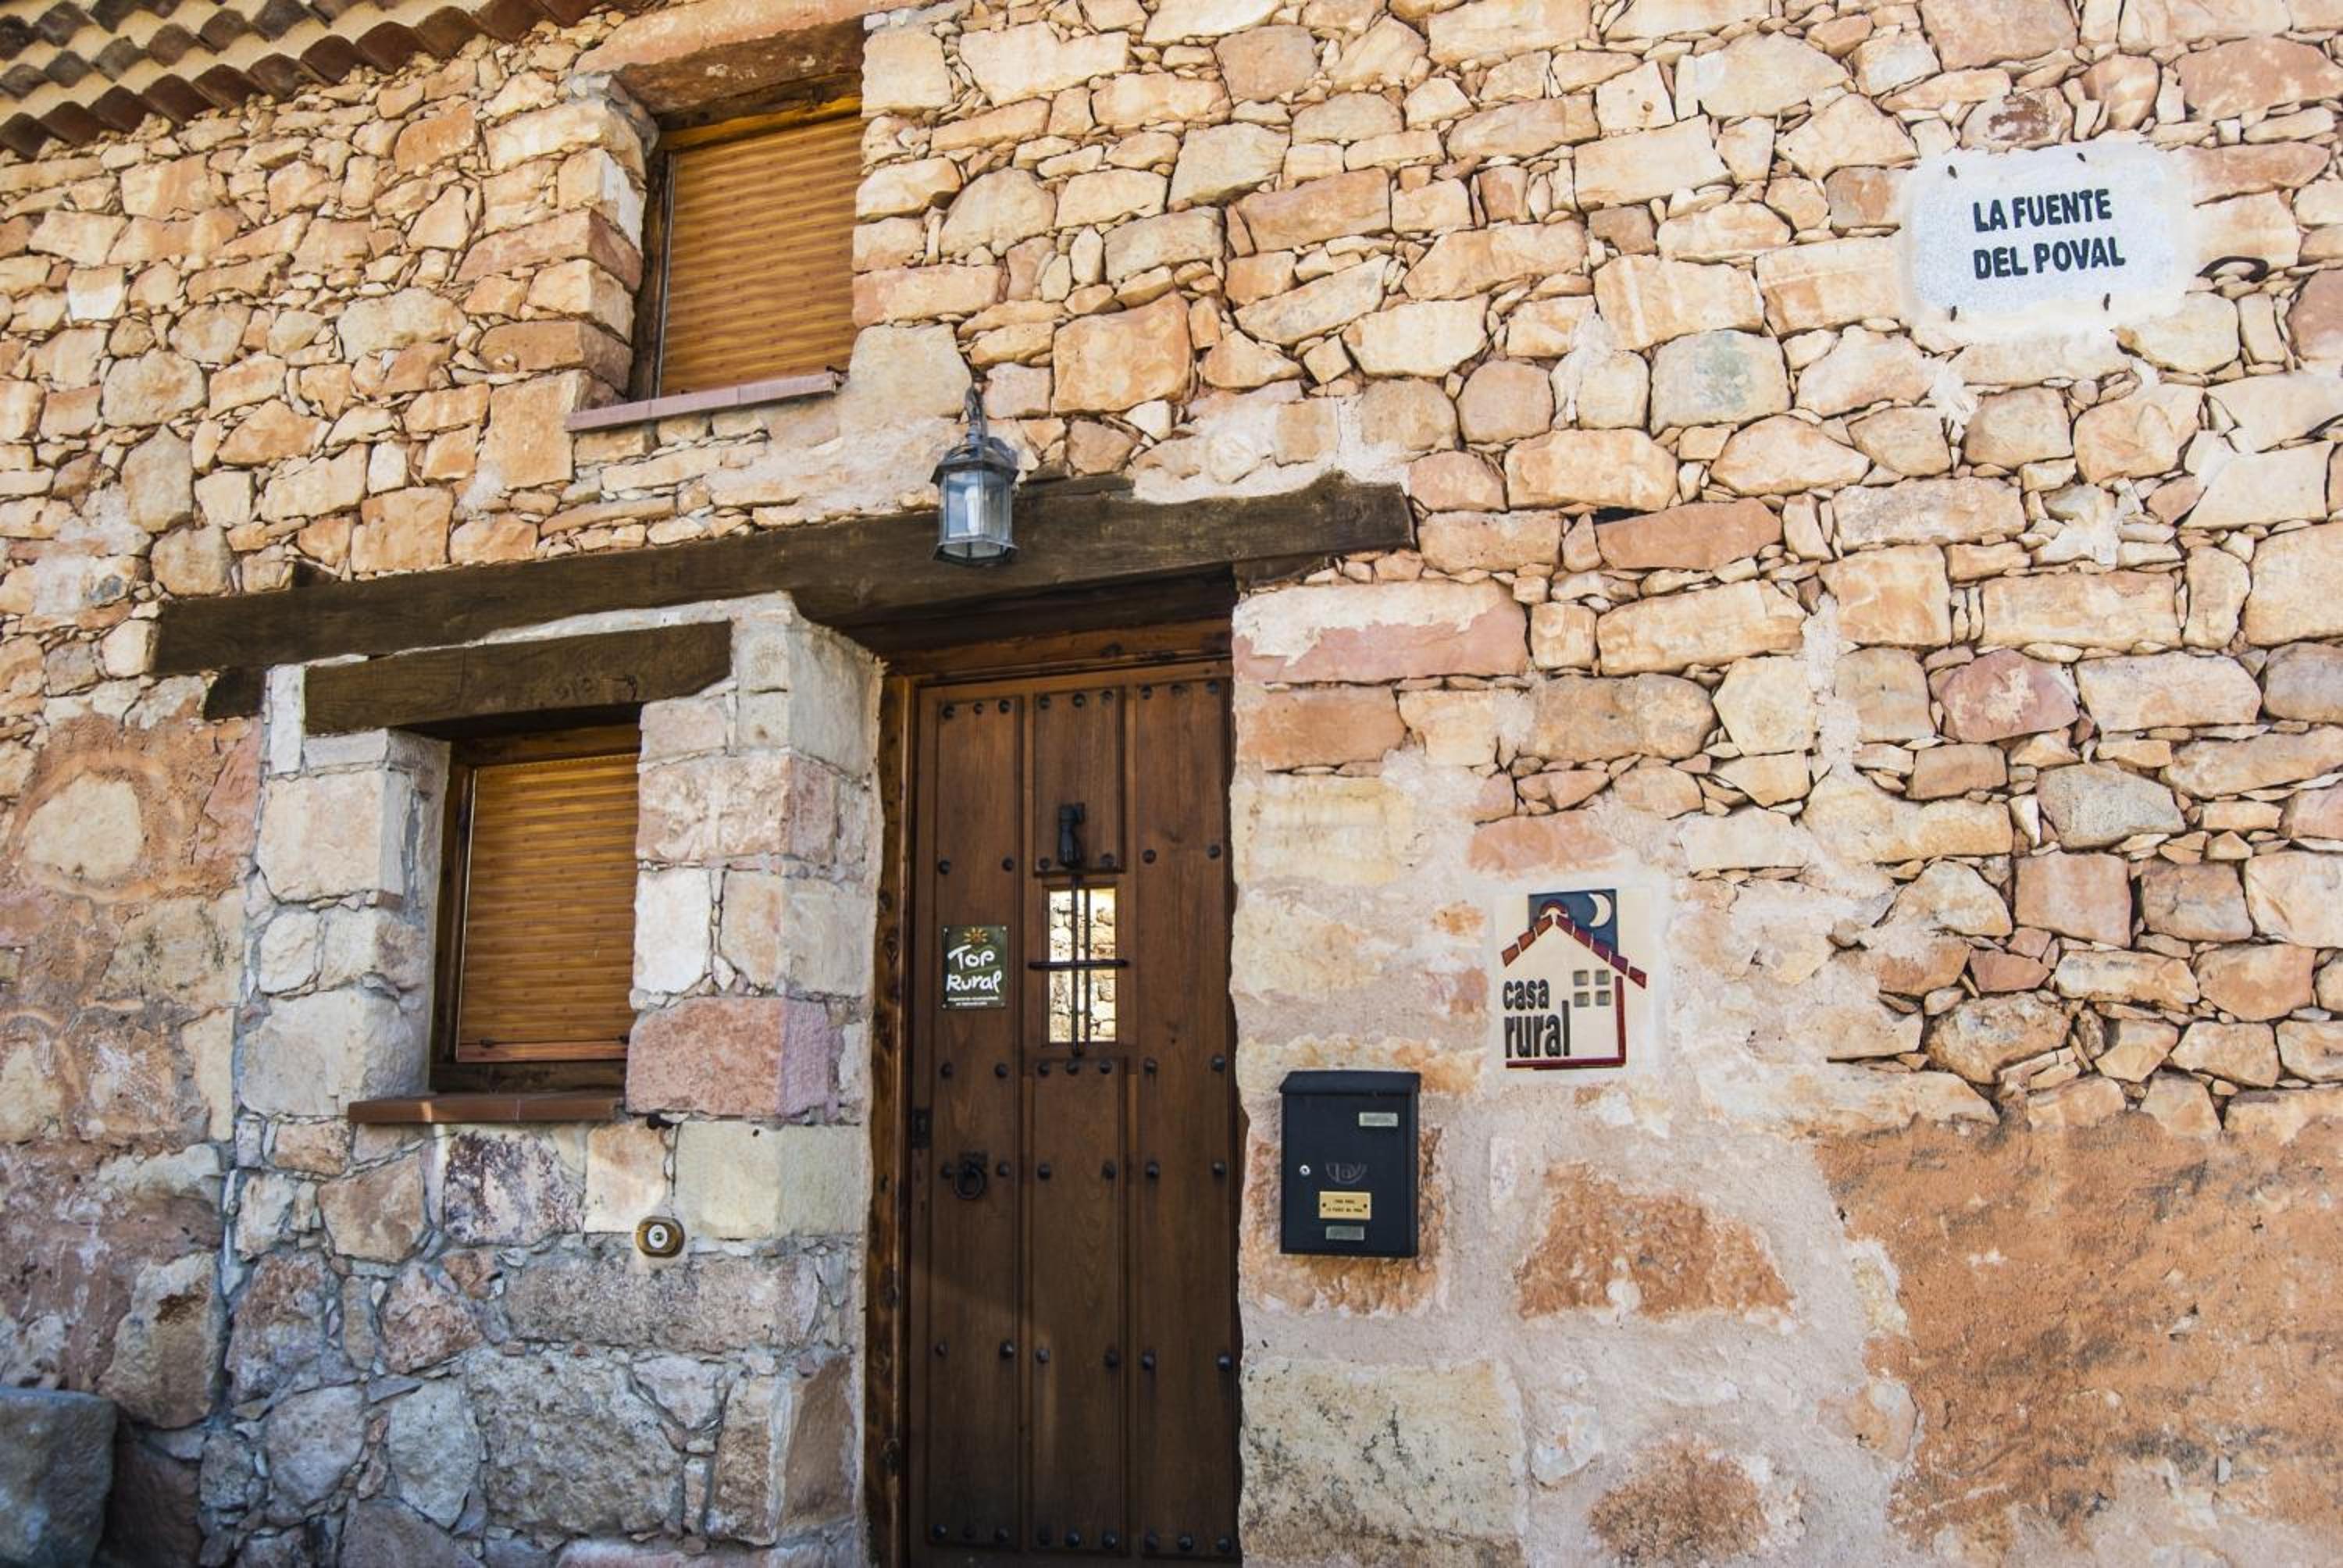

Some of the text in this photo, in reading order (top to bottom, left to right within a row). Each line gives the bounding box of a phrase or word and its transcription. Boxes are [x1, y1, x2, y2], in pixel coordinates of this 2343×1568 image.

[1973, 188, 2113, 233] LA FUENTE
[1973, 236, 2126, 280] DEL POVAL
[946, 969, 1003, 994] Rural
[1503, 978, 1550, 1010] casa
[1504, 1000, 1571, 1059] rural
